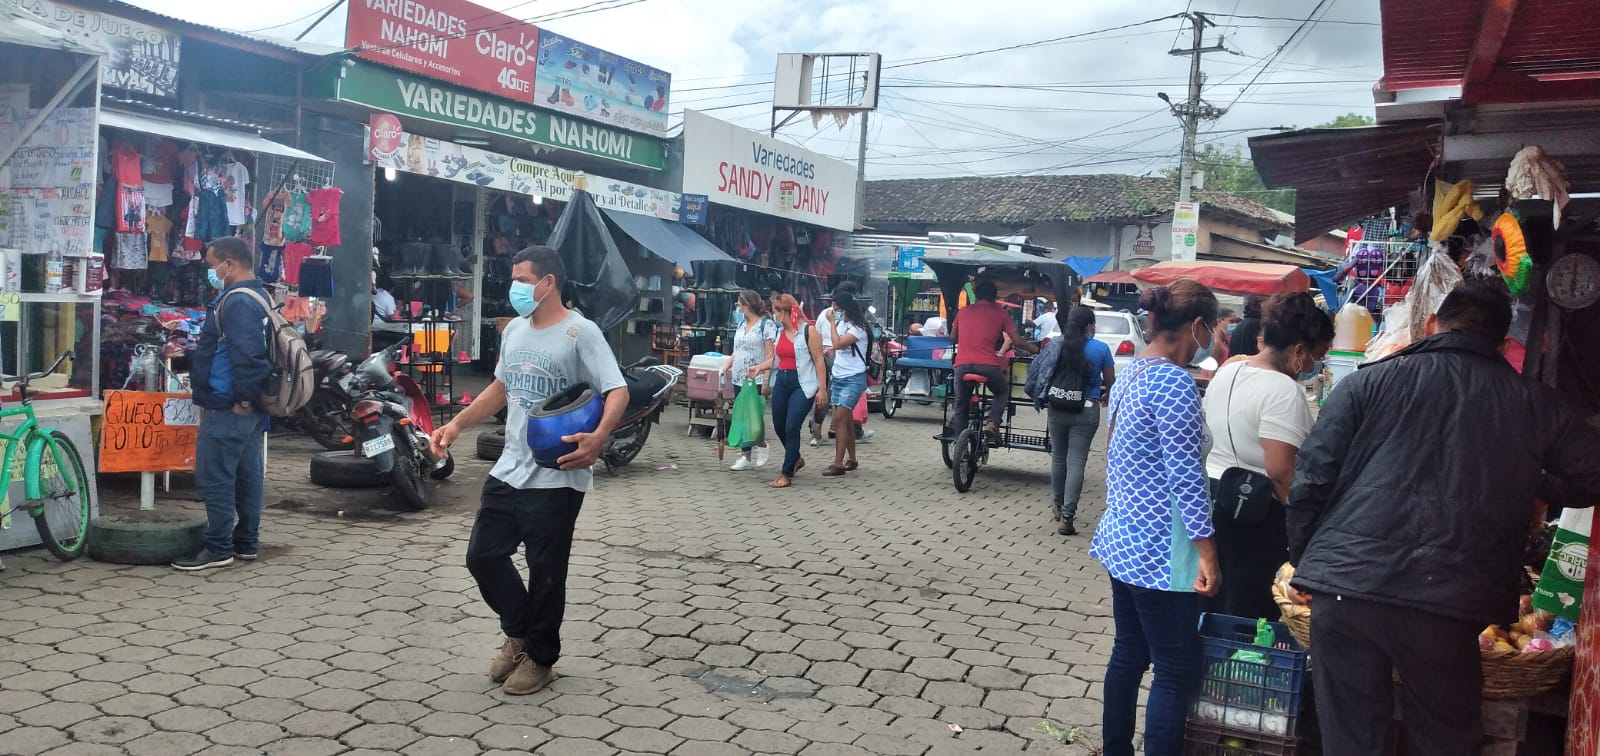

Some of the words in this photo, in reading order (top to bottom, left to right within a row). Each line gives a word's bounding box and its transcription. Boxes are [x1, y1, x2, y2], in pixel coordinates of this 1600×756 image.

[54, 6, 85, 28] DE
[90, 15, 162, 45] JUEGO
[365, 0, 467, 39] VARIEDADES
[381, 19, 449, 59] NAHOMI
[475, 29, 527, 67] Claro
[391, 48, 423, 65] Celulares
[428, 60, 461, 77] Accesorios
[374, 128, 397, 139] Claro
[396, 78, 537, 135] VARIEDADES
[549, 115, 633, 159] NAHOMI
[510, 157, 549, 178] Compre
[752, 142, 815, 180] Variedades
[535, 178, 547, 193] Al
[550, 184, 565, 197] por
[608, 192, 617, 206] al
[618, 195, 649, 211] Detalle
[718, 161, 775, 203] SANDY
[792, 182, 830, 216] DANY
[106, 391, 164, 425] QUESO
[104, 425, 153, 450] POLLO
